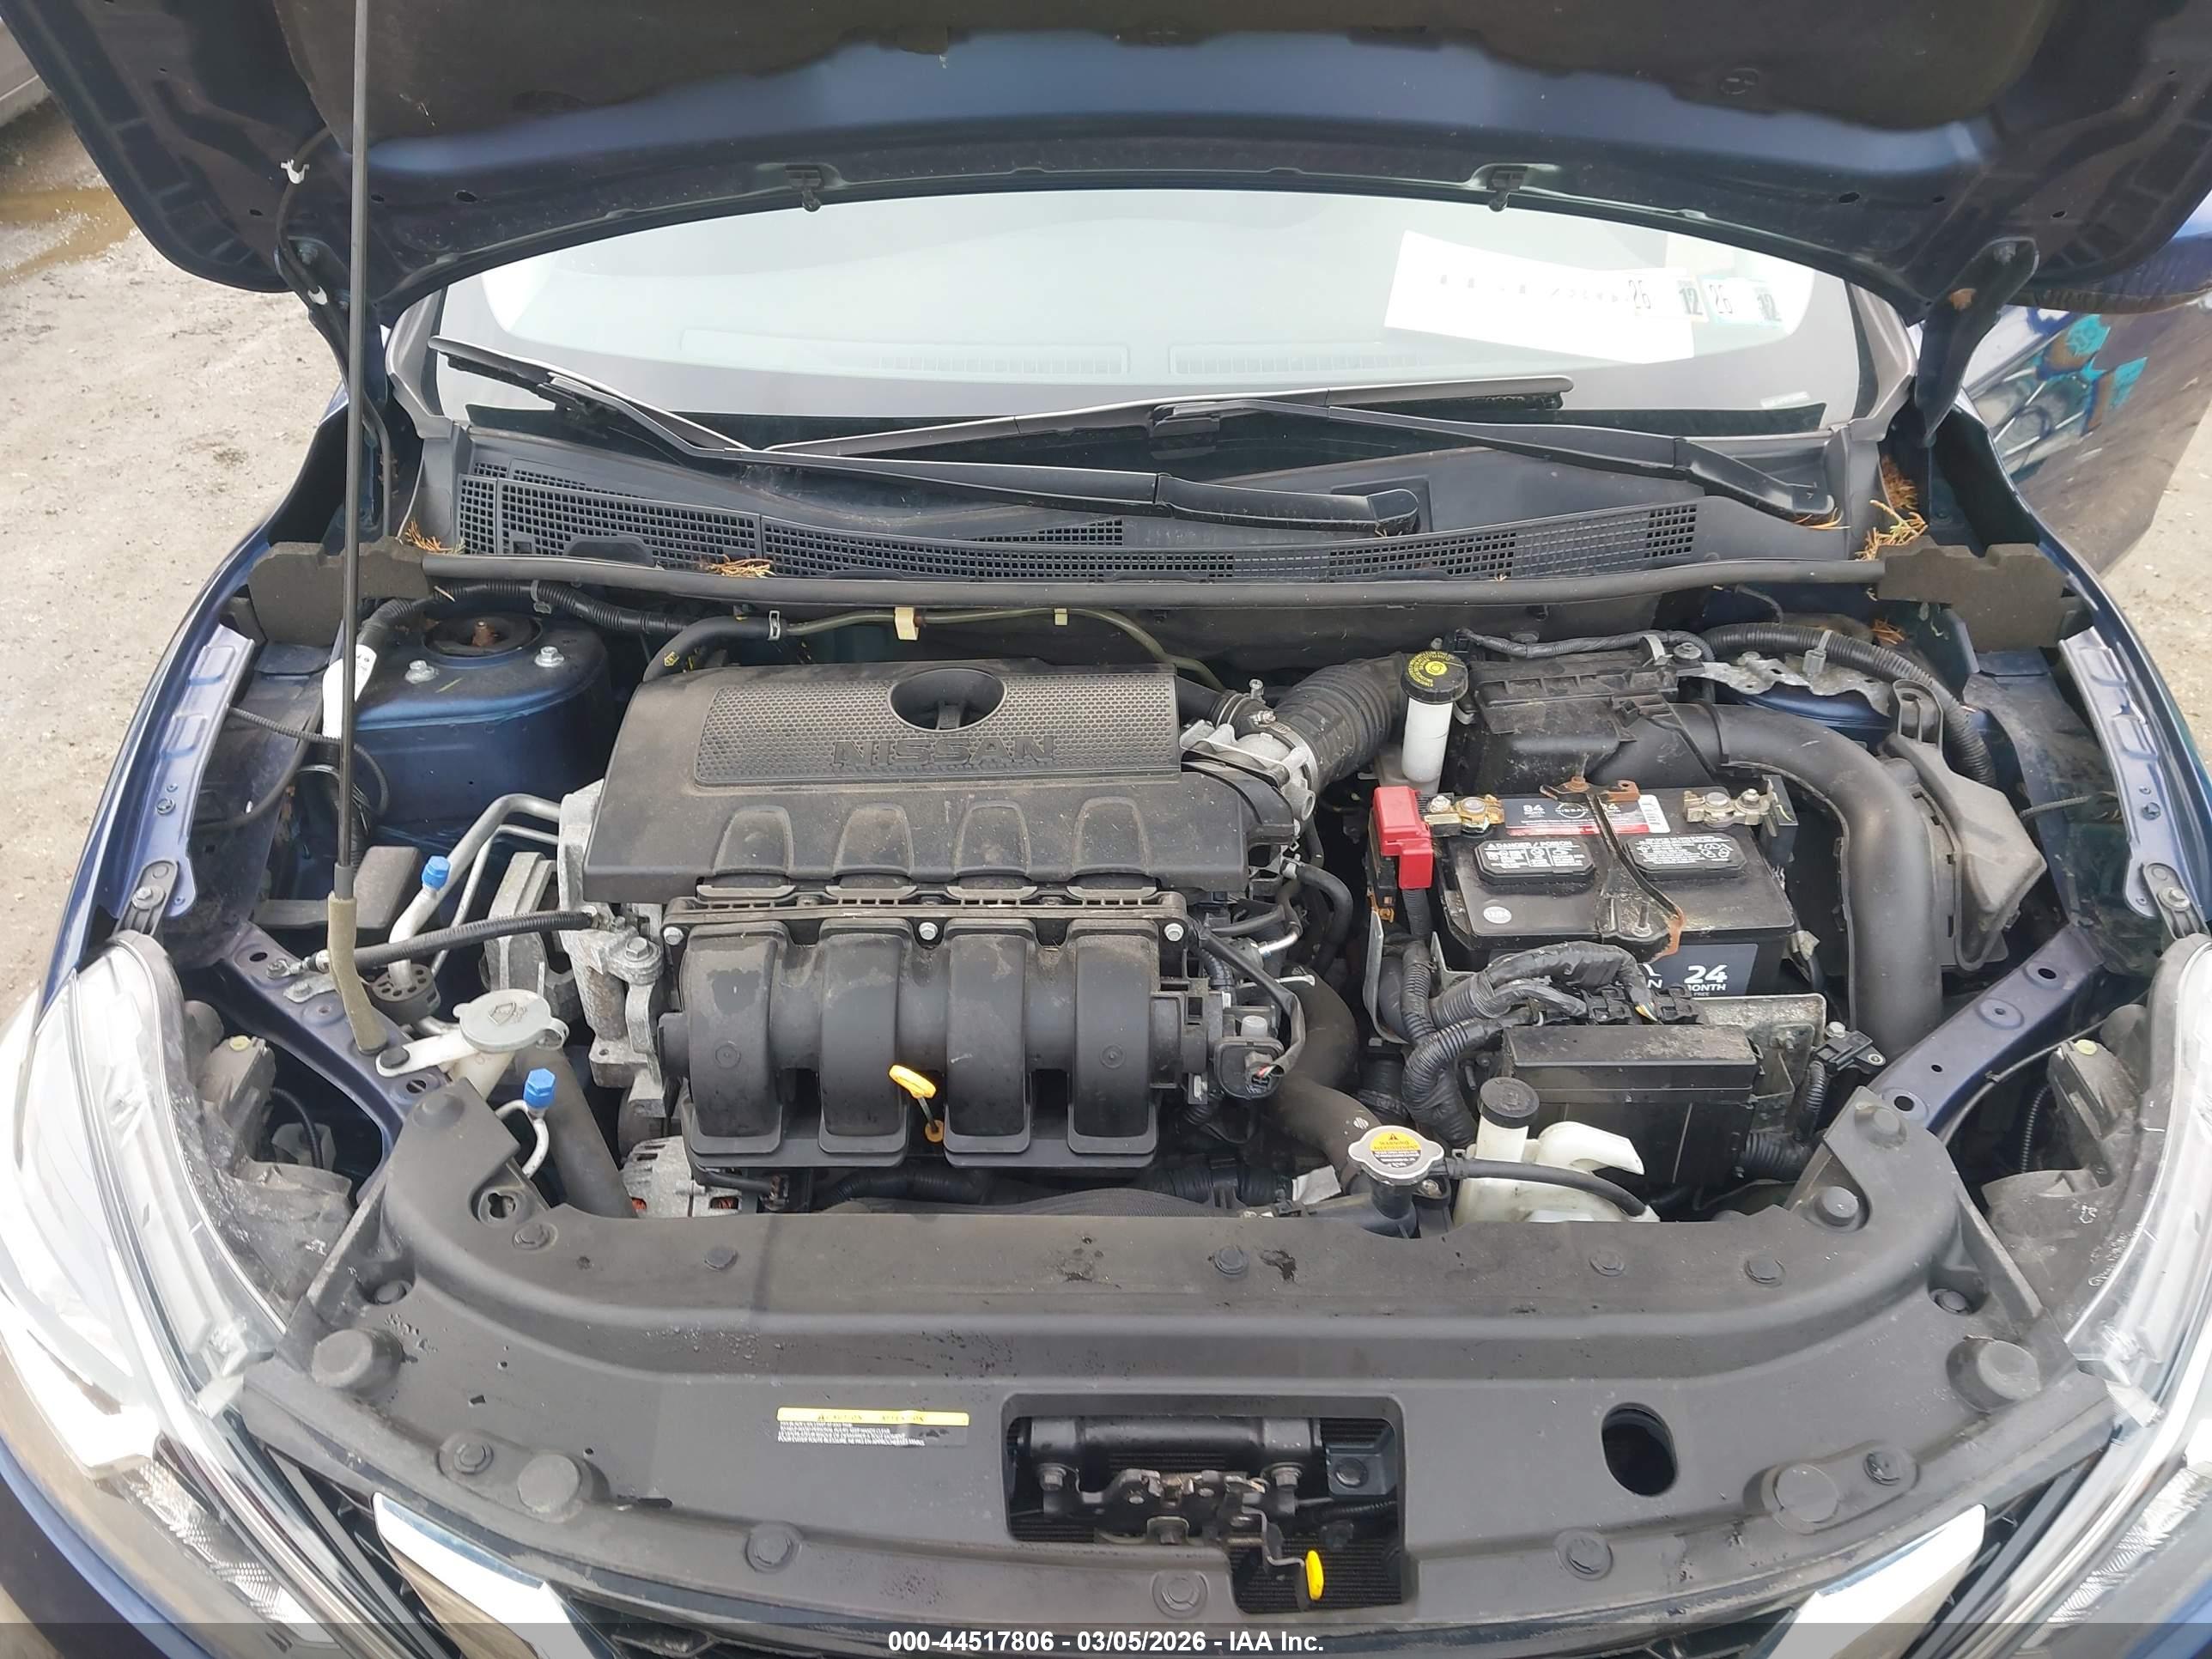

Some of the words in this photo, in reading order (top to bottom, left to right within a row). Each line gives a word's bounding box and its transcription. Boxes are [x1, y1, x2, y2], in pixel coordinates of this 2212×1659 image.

[1679, 288, 1704, 315] 12
[833, 735, 1054, 766] NISSAN
[1684, 964, 1728, 984] 24
